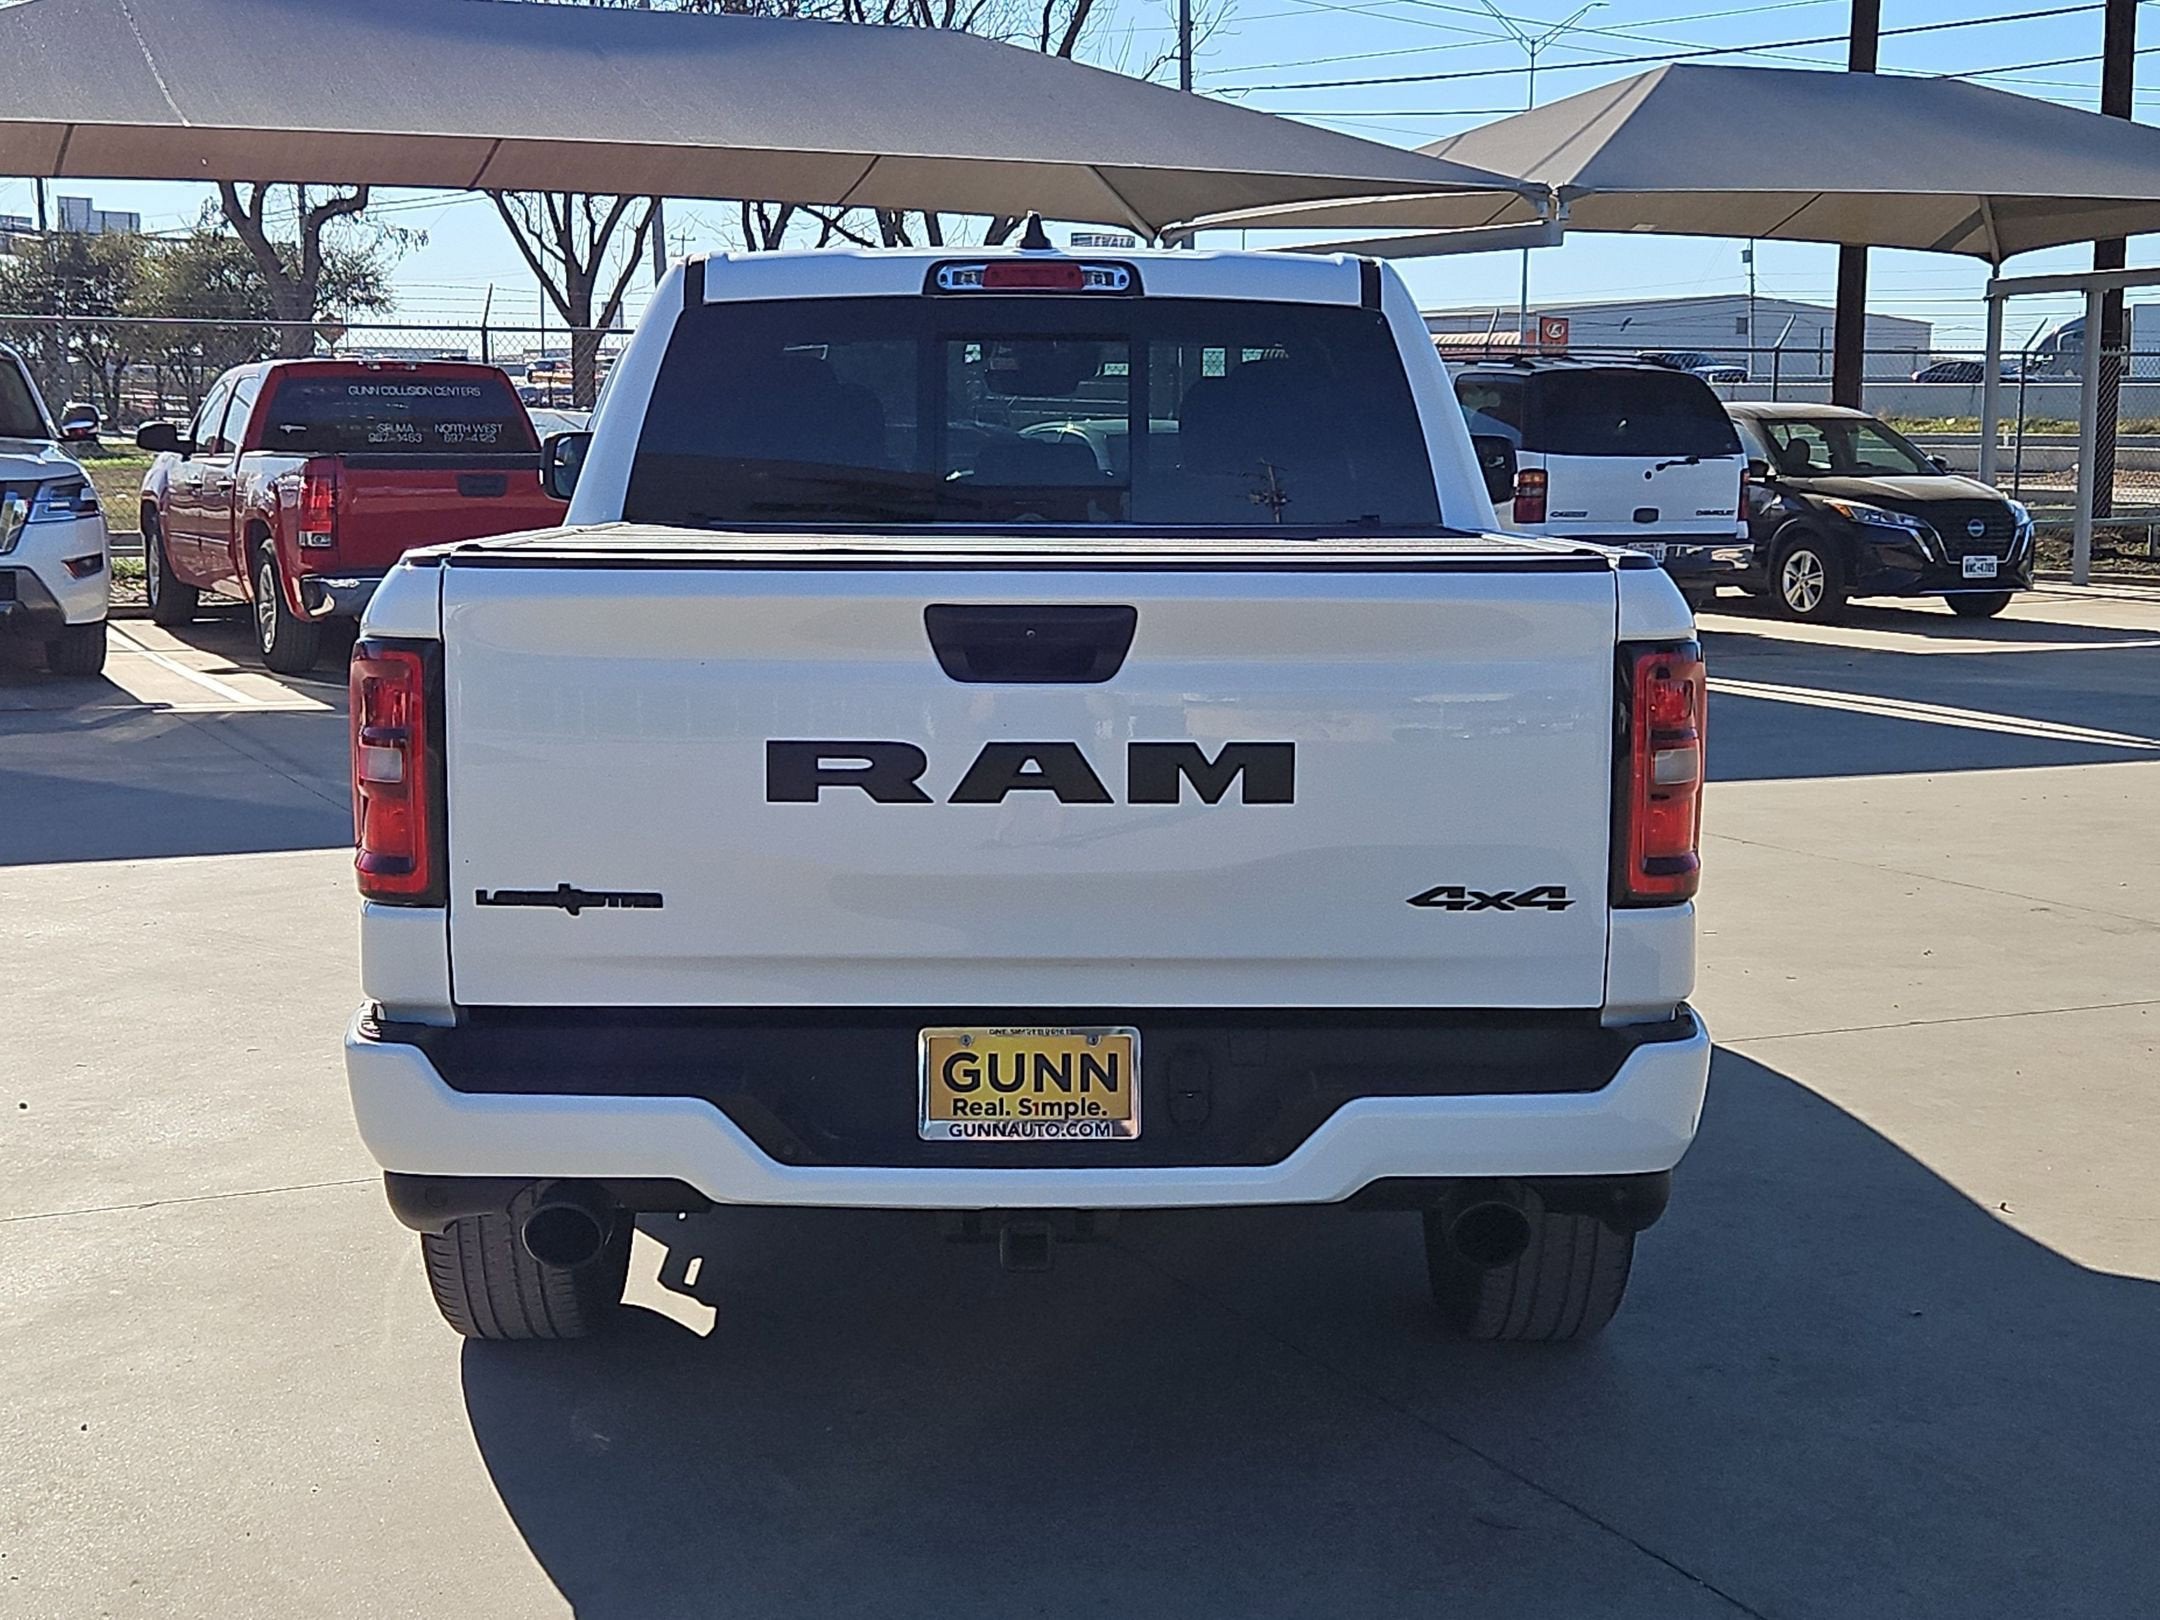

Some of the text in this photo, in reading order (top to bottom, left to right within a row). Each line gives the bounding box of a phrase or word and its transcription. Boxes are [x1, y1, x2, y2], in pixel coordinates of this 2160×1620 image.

[348, 386, 480, 396] GUNN COLLISION CENTERS
[766, 740, 1295, 804] RAM
[942, 1052, 1118, 1093] GUNN
[952, 1098, 1011, 1116] Real.
[949, 1123, 1111, 1137] GUNNAUTO.COM
